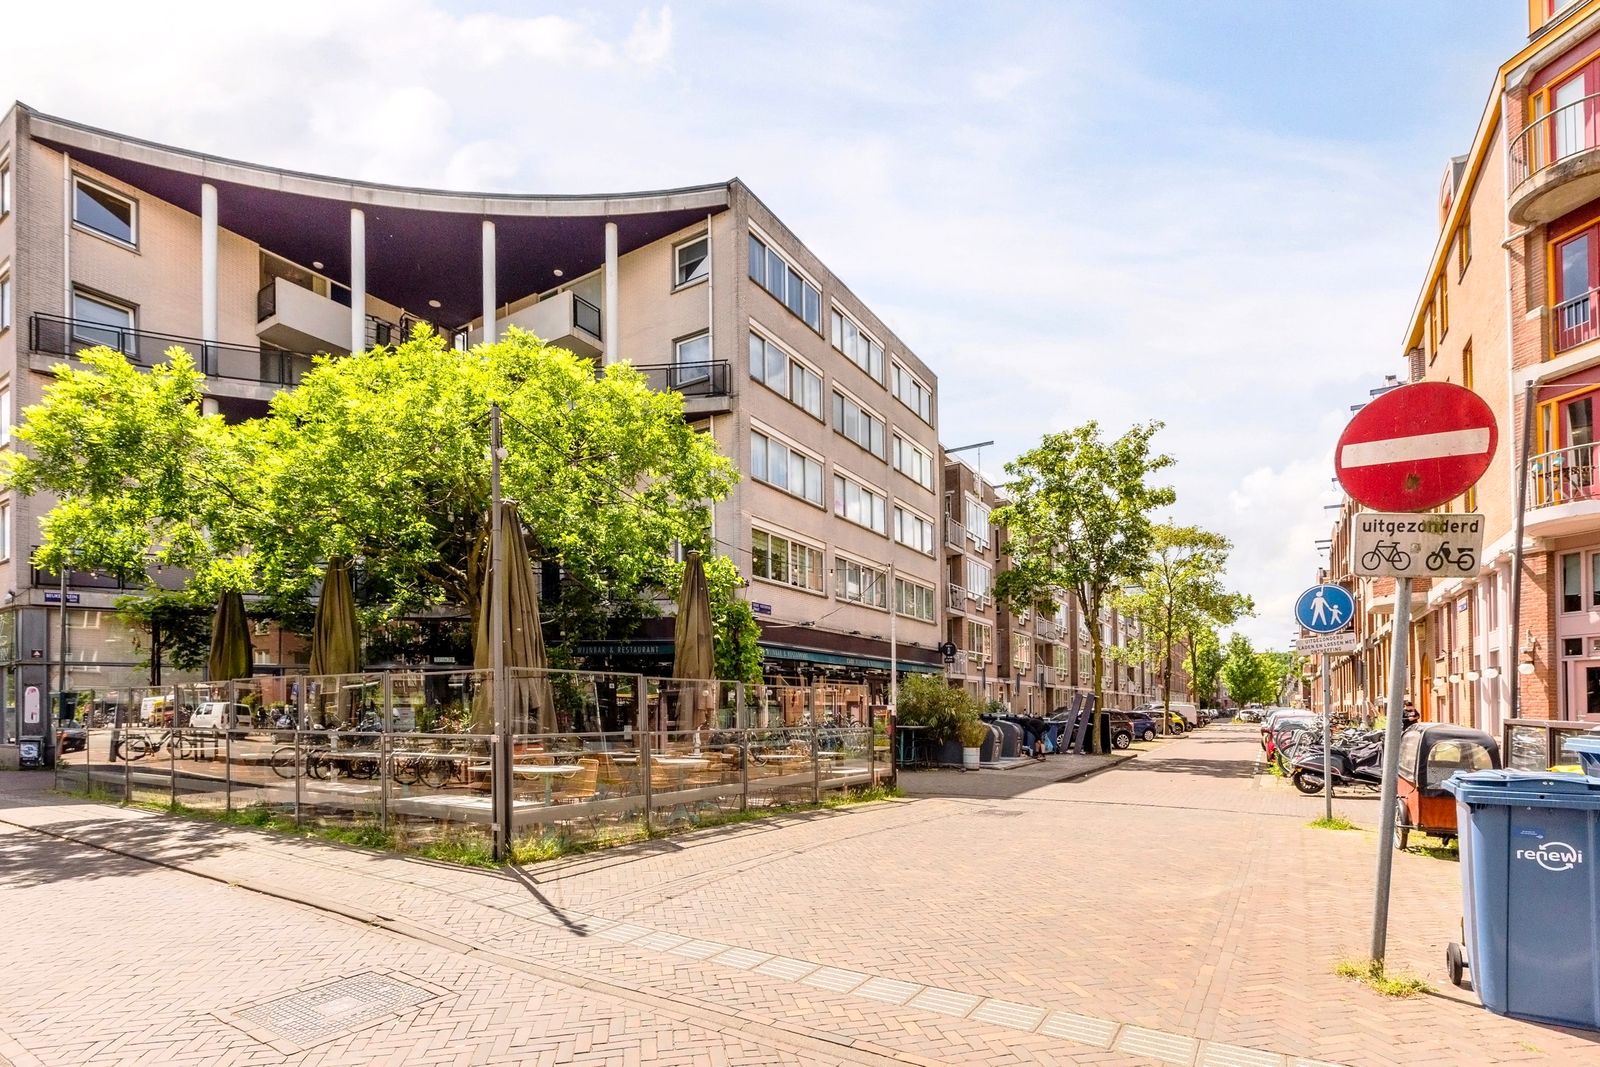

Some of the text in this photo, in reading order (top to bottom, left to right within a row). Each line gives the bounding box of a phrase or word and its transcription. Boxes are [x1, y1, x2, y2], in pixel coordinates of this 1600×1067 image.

[1362, 519, 1479, 537] uitgezonderd
[1305, 635, 1344, 644] UITGEZONDERD
[609, 646, 614, 654] &
[618, 645, 659, 654] RESTAURANT
[1516, 848, 1583, 864] renewi
